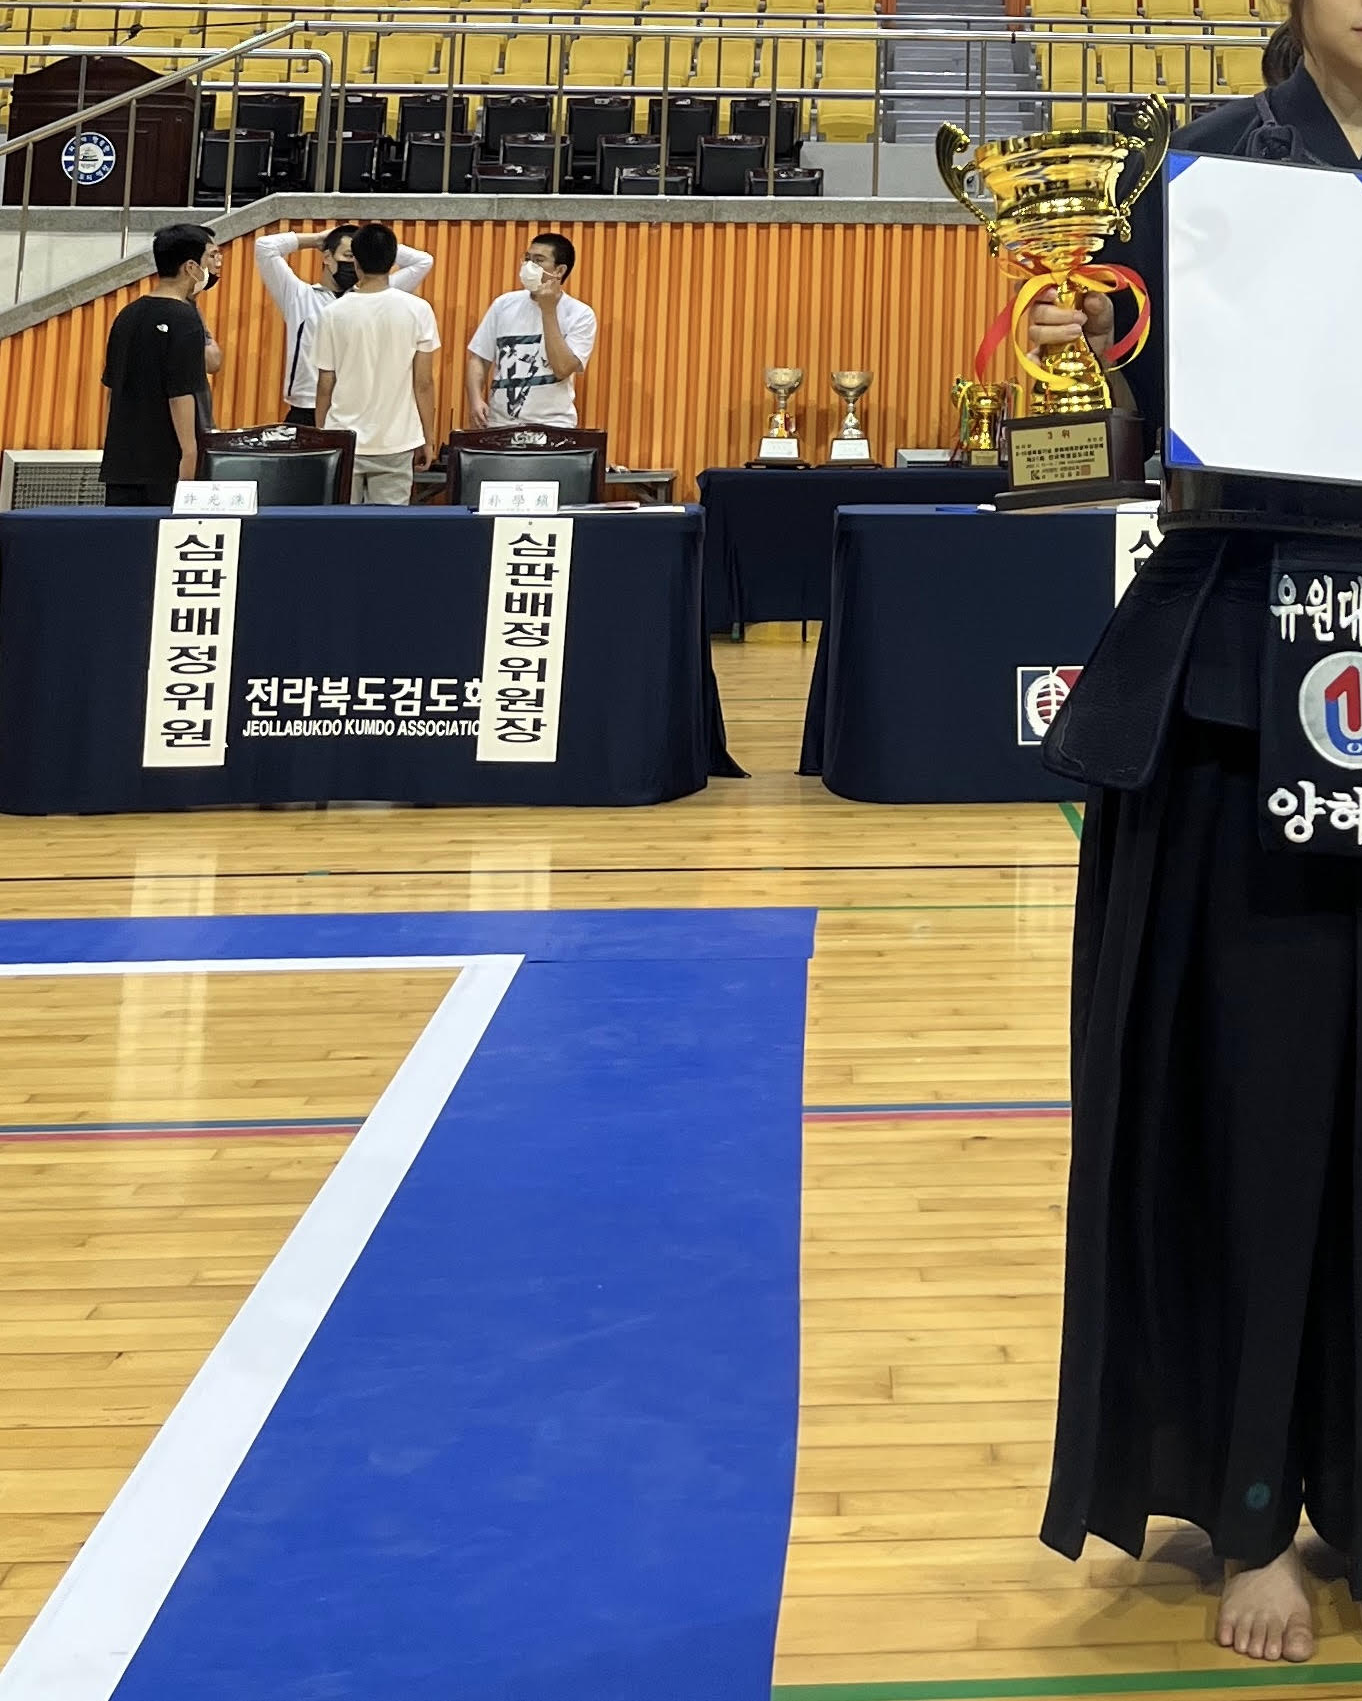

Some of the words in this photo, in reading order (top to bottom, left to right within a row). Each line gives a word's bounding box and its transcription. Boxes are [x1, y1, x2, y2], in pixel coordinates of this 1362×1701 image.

[242, 719, 342, 737] JEOLLABUKDO
[344, 719, 396, 737] KUMDO
[397, 718, 481, 737] ASSOCIATIO
